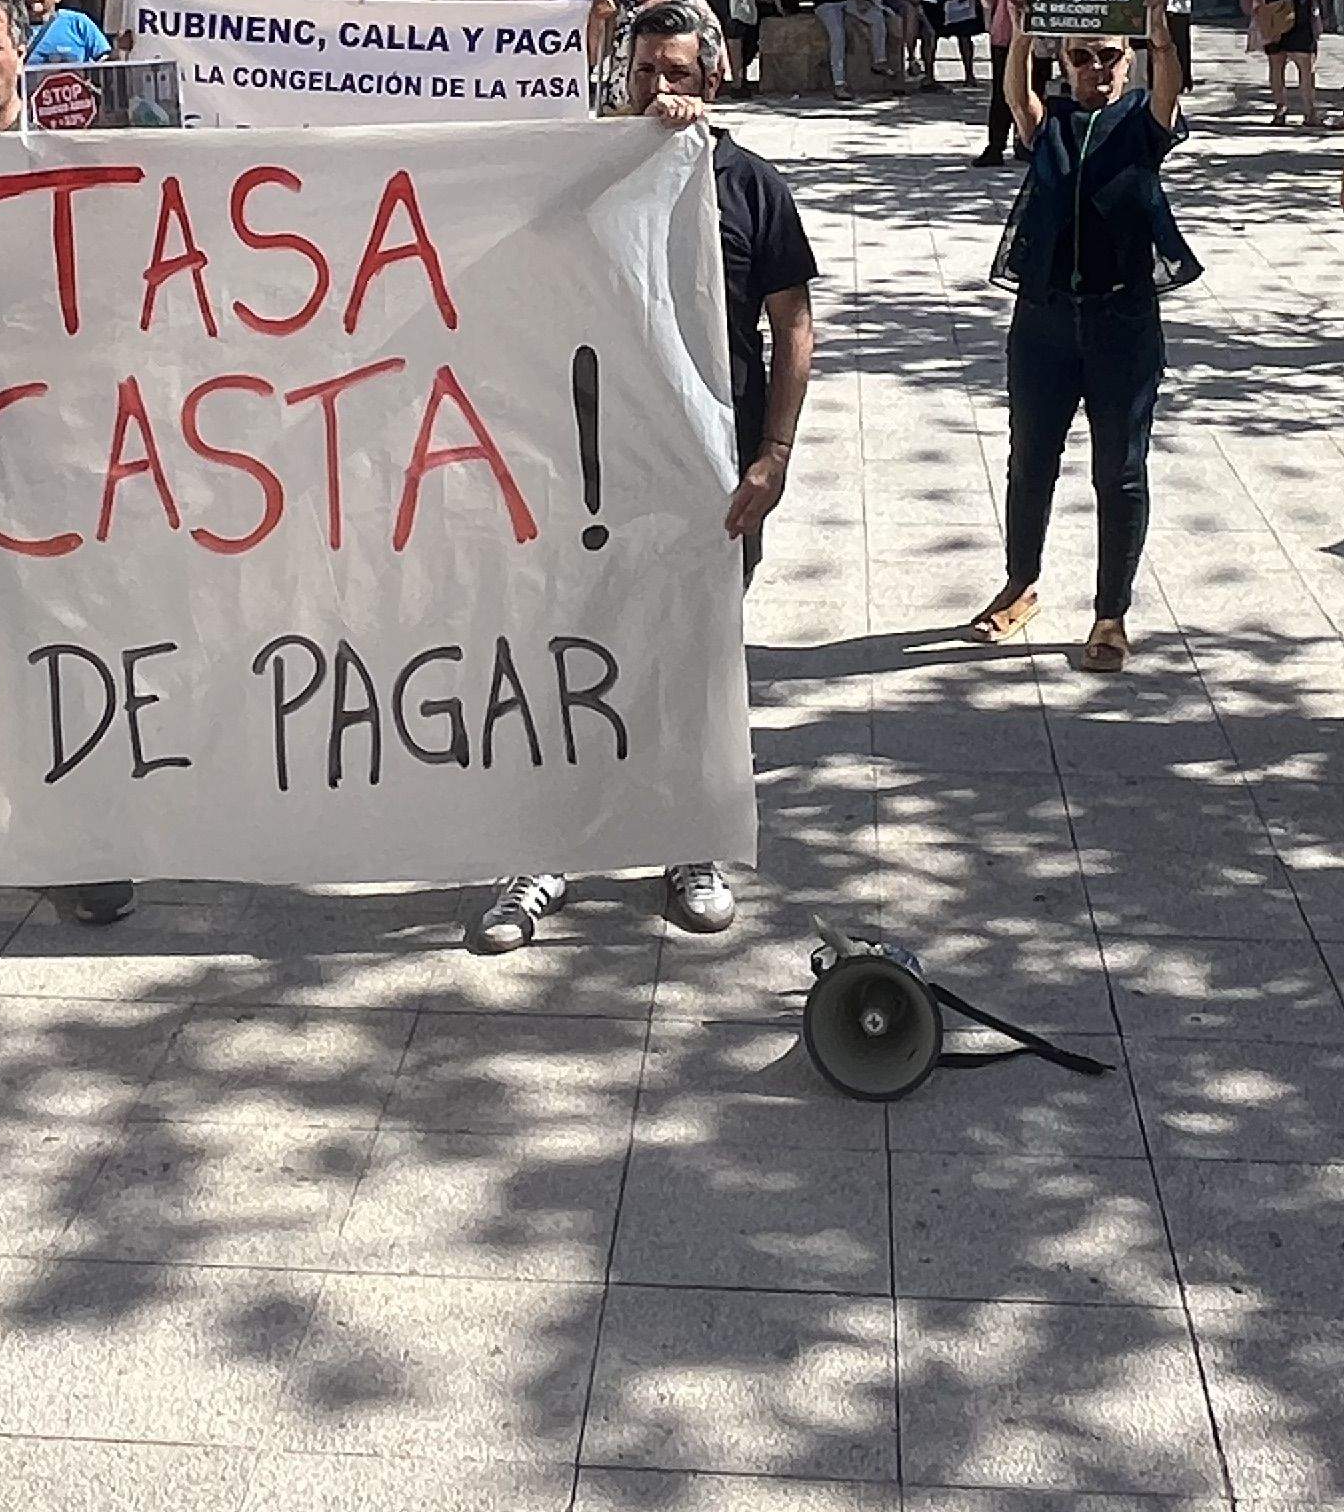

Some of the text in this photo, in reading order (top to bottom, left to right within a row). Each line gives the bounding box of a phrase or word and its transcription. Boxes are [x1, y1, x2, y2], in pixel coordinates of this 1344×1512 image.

[138, 8, 582, 56] RUBINENC, CALLA Y PAGA
[42, 83, 82, 105] STOP
[194, 64, 226, 86] LA
[232, 65, 422, 97] CONGELACIÓN
[432, 76, 466, 98] DE
[474, 78, 508, 100] LA
[516, 77, 580, 98] TASA
[27, 641, 193, 785] DE
[253, 635, 629, 792] PAGAR
